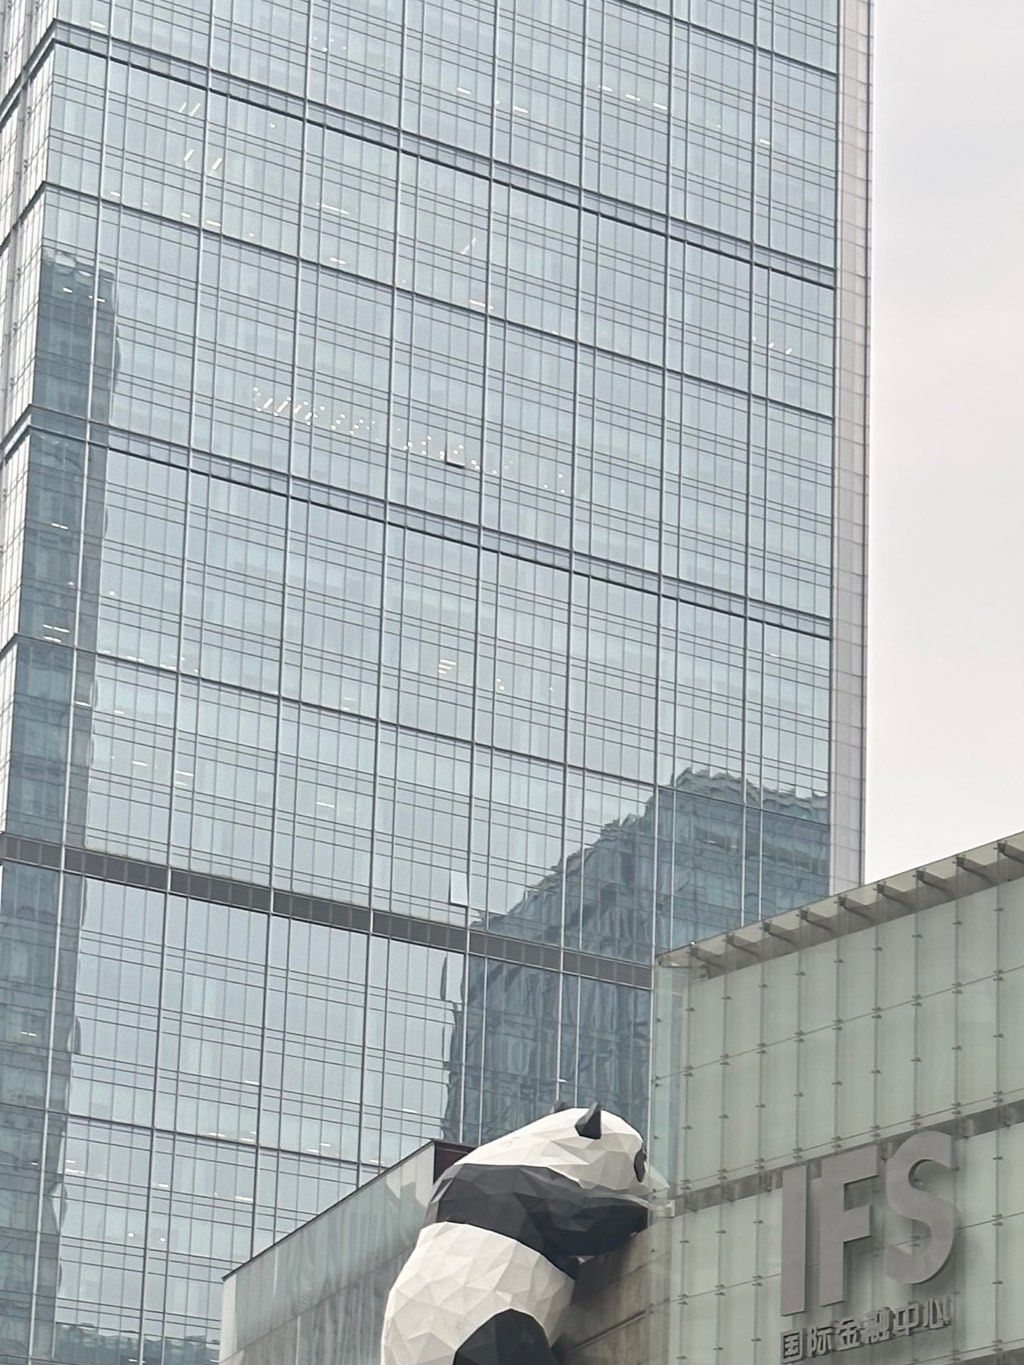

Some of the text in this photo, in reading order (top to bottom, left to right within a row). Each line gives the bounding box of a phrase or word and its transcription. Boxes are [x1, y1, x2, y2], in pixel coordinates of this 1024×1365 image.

[781, 1131, 958, 1317] IFS
[780, 1297, 953, 1365] 国际金融中心
